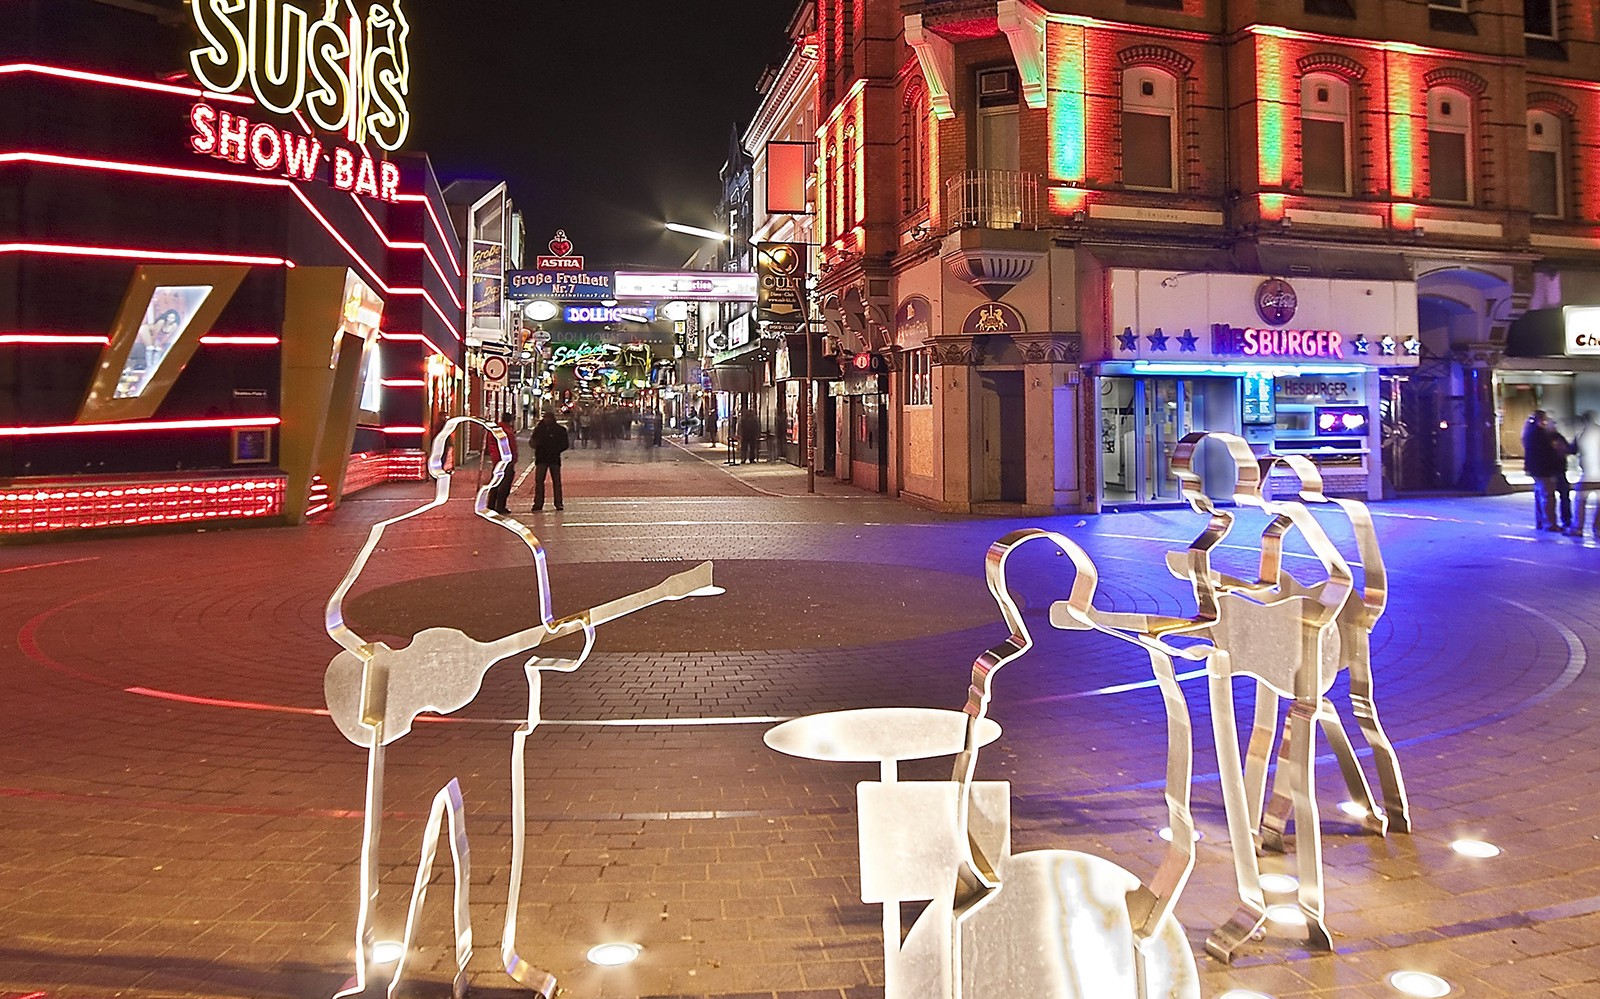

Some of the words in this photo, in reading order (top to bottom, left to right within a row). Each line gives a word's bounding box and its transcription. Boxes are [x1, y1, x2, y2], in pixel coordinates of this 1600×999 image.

[190, 102, 322, 182] SHOW
[333, 147, 400, 203] BAR
[541, 259, 580, 268] ASTRA
[512, 274, 553, 287] Große
[556, 272, 609, 287] Freiheit
[762, 274, 801, 290] CULT
[552, 284, 576, 294] Nr.7
[1211, 324, 1343, 360] HESBURGER
[1284, 381, 1348, 396] HESBURGER
